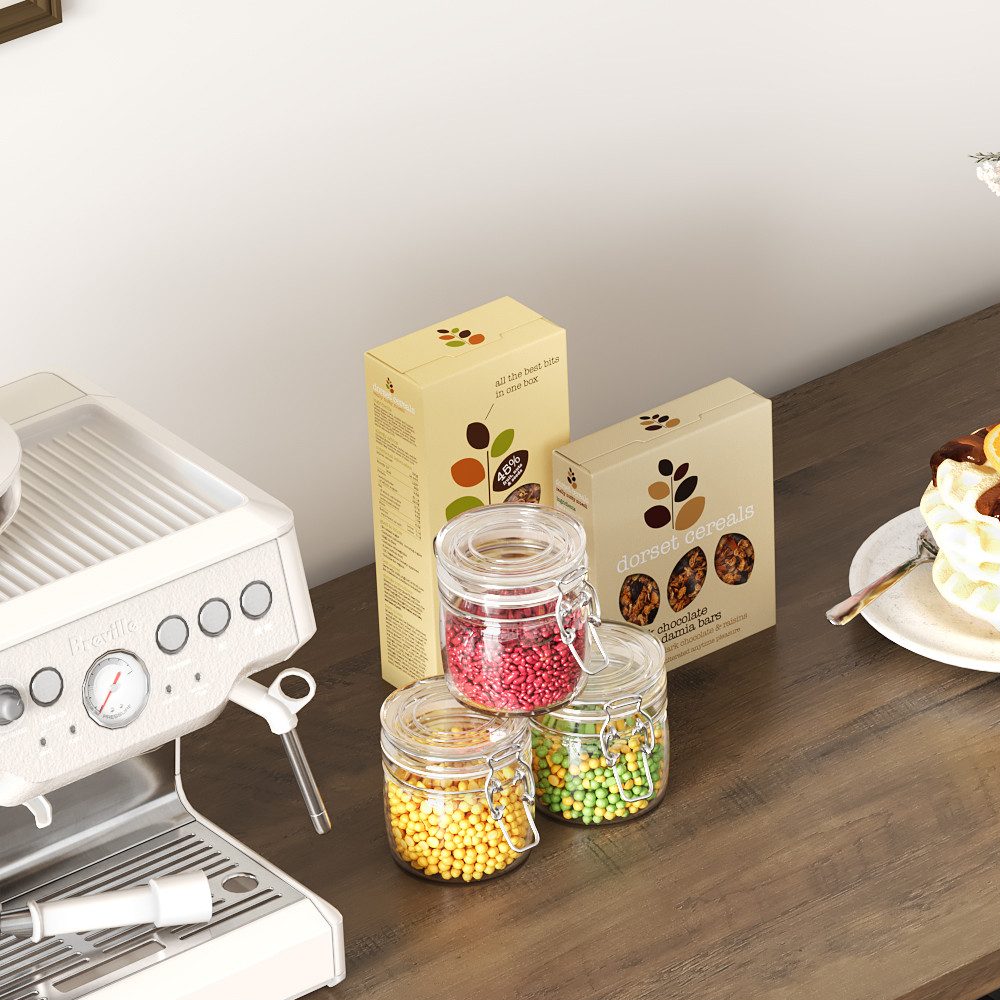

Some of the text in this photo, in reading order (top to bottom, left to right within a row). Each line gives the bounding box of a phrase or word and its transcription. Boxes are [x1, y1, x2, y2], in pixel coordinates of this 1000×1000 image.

[495, 356, 560, 388] all the best bits
[495, 375, 539, 399] in one box
[497, 455, 521, 482] 45%
[616, 503, 755, 574] dorset cereals
[657, 606, 708, 635] chocolate
[661, 611, 722, 643] damia bars
[680, 627, 714, 647] chocolate
[715, 624, 722, 632] &
[722, 613, 748, 628] raisins
[68, 620, 137, 656] Breville
